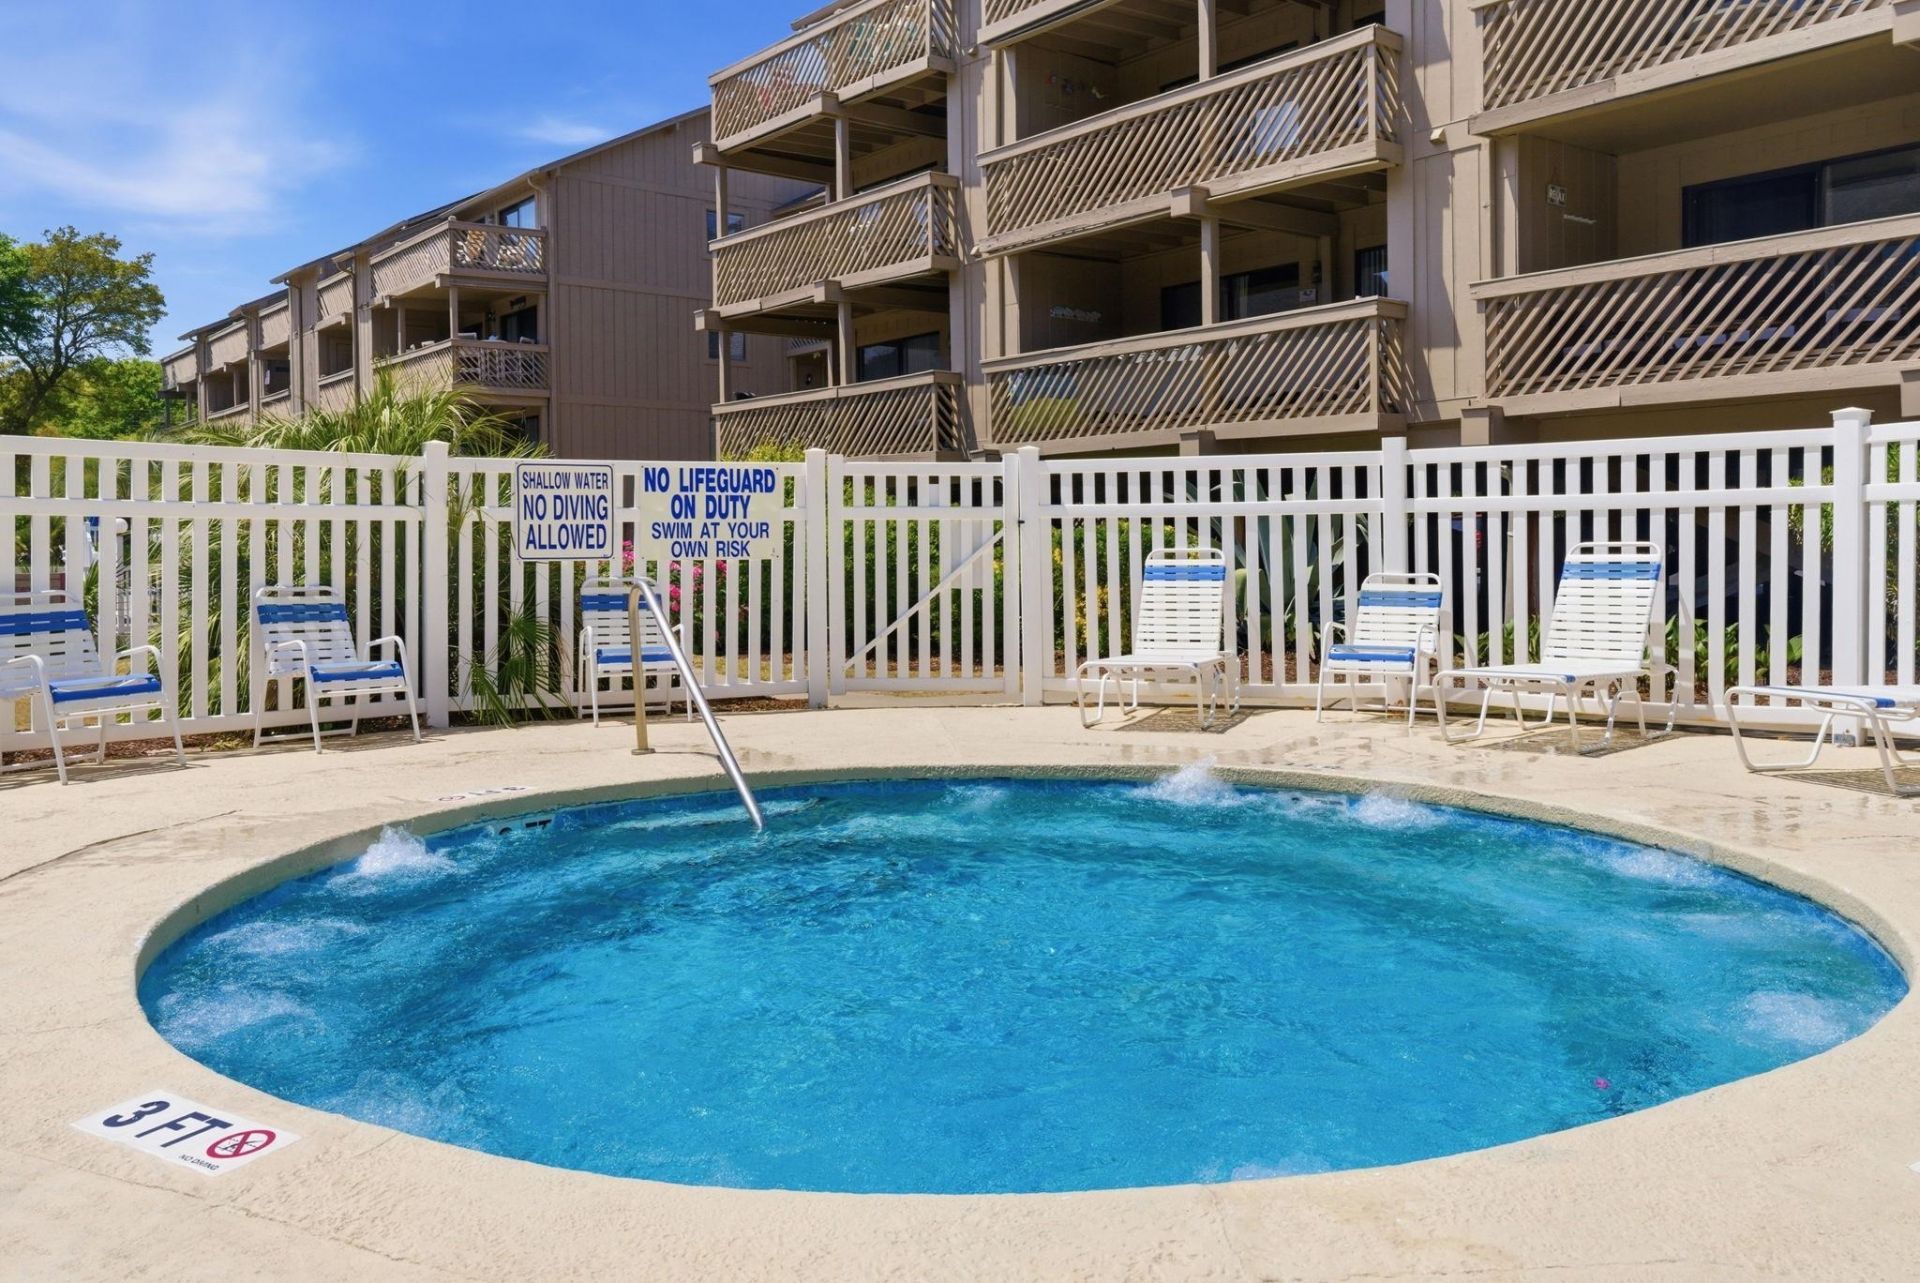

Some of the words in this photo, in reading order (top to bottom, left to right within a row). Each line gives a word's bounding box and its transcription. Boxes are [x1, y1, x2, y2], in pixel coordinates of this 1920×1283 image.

[522, 472, 571, 489] SHALLOW
[574, 473, 609, 489] WATER
[644, 467, 670, 492] NO
[679, 469, 776, 493] LIFEGUARD
[523, 495, 548, 520] NO
[553, 495, 609, 520] DIVING
[671, 495, 696, 519] ON
[705, 495, 751, 519] DUTY
[526, 524, 607, 549] ALLOWED
[651, 522, 692, 539] SWIM
[700, 523, 720, 538] AT
[727, 523, 769, 538] YOUR
[671, 541, 708, 557] OWN
[716, 541, 750, 557] RISK
[102, 1100, 170, 1127] 3
[135, 1111, 233, 1148] FT
